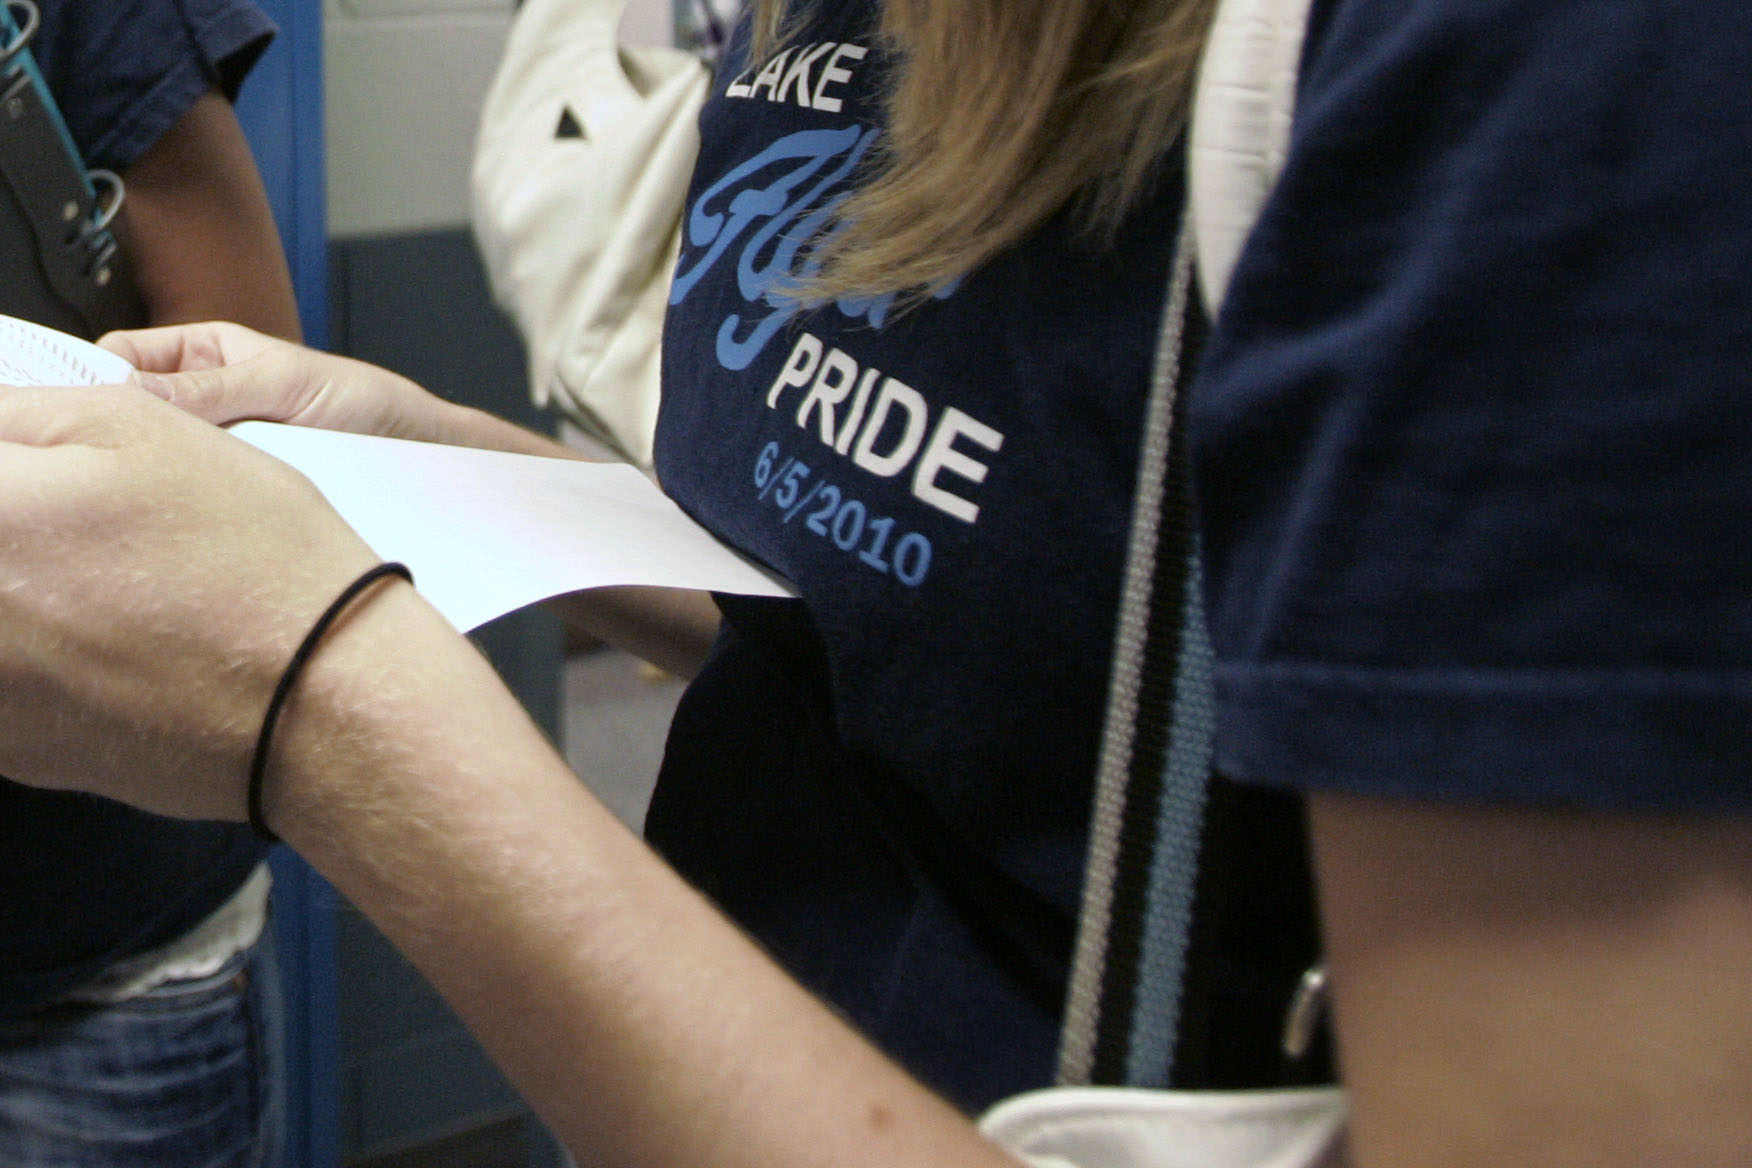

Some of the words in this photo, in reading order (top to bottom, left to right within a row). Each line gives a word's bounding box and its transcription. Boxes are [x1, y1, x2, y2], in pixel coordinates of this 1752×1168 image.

[725, 41, 869, 113] LAKE
[766, 332, 1005, 524] PRIDE
[754, 442, 933, 587] 6/5/2010
